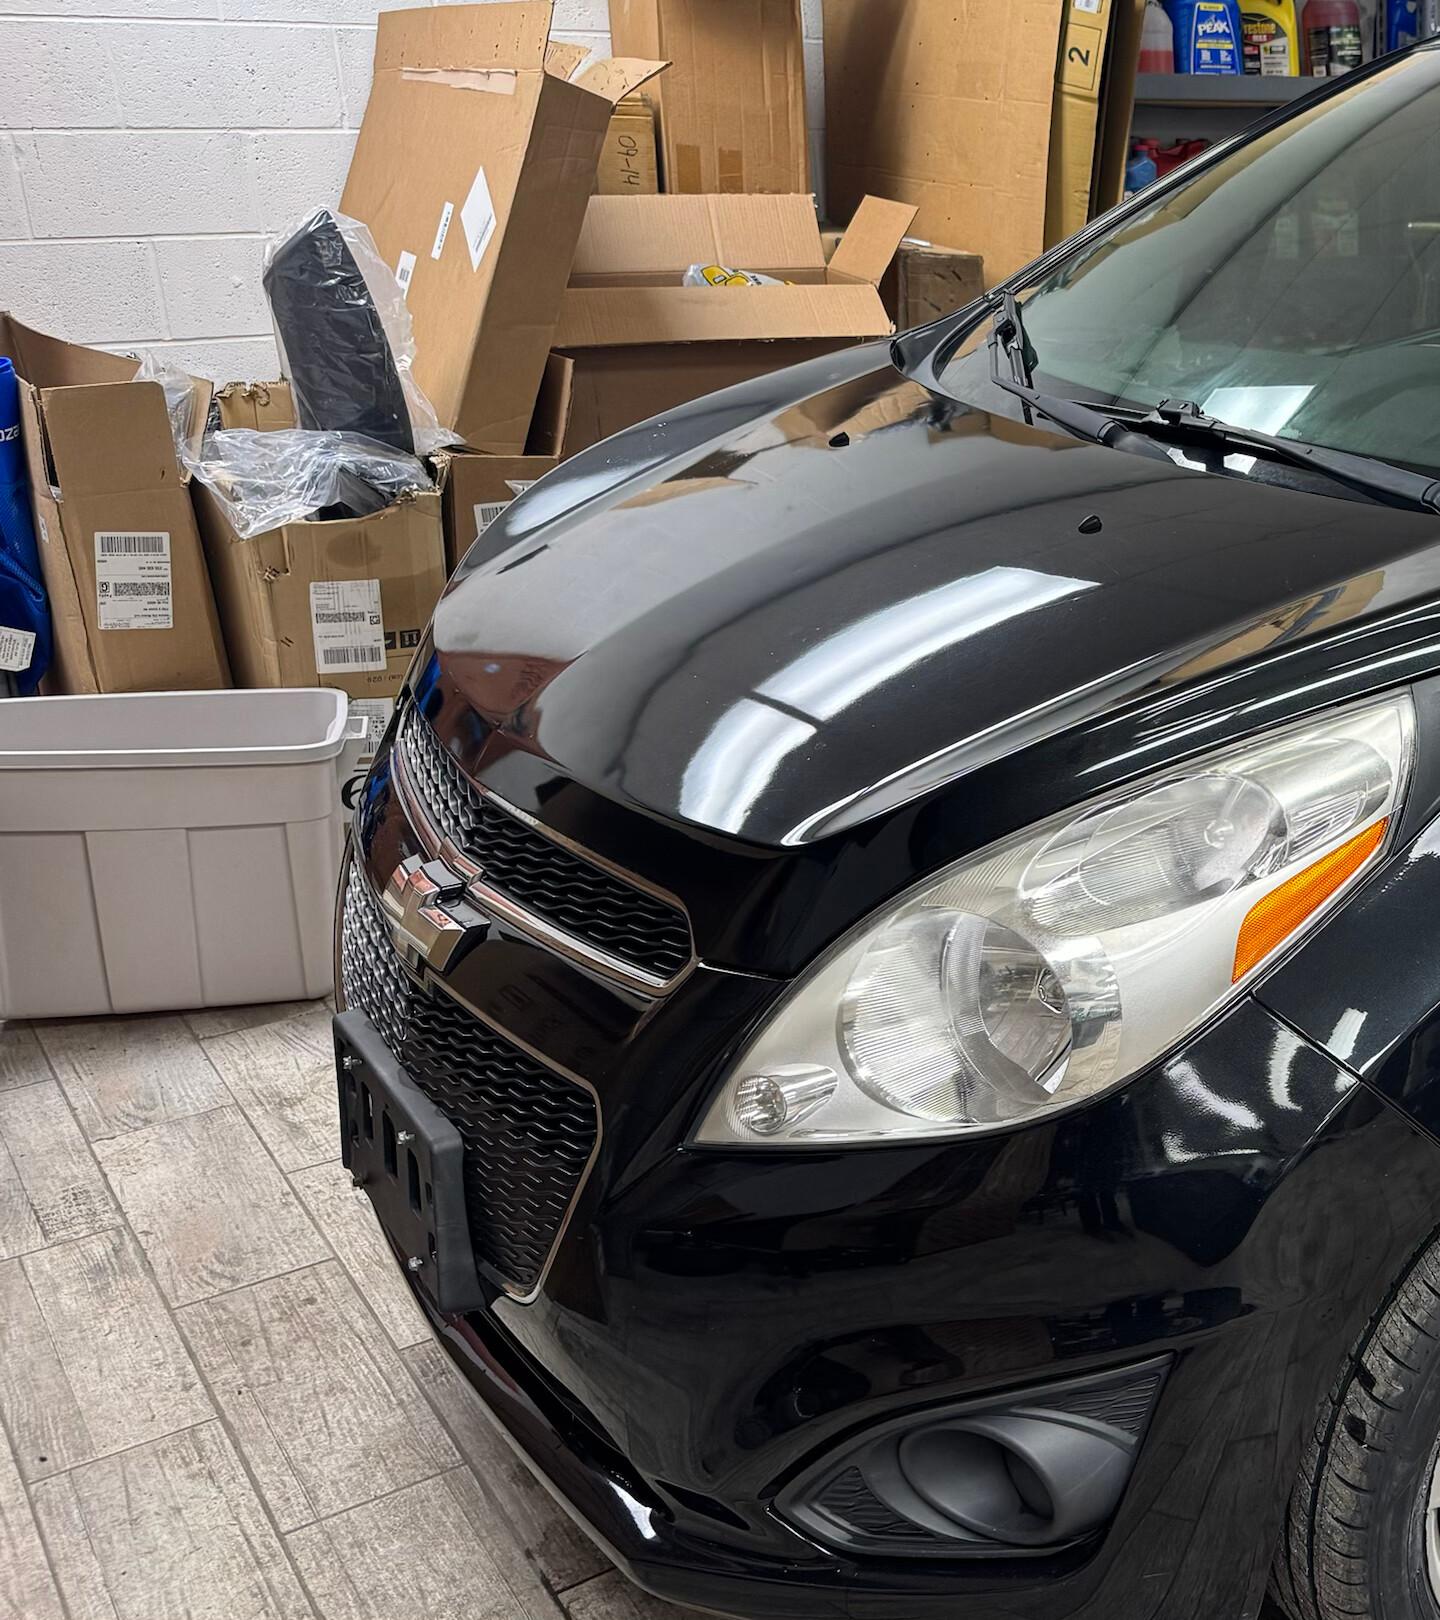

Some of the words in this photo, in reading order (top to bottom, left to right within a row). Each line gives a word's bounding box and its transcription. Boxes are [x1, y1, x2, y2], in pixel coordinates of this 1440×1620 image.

[1197, 20, 1231, 37] PEAK
[1243, 22, 1276, 35] restone
[1068, 47, 1090, 66] 2
[618, 135, 641, 186] 09-14
